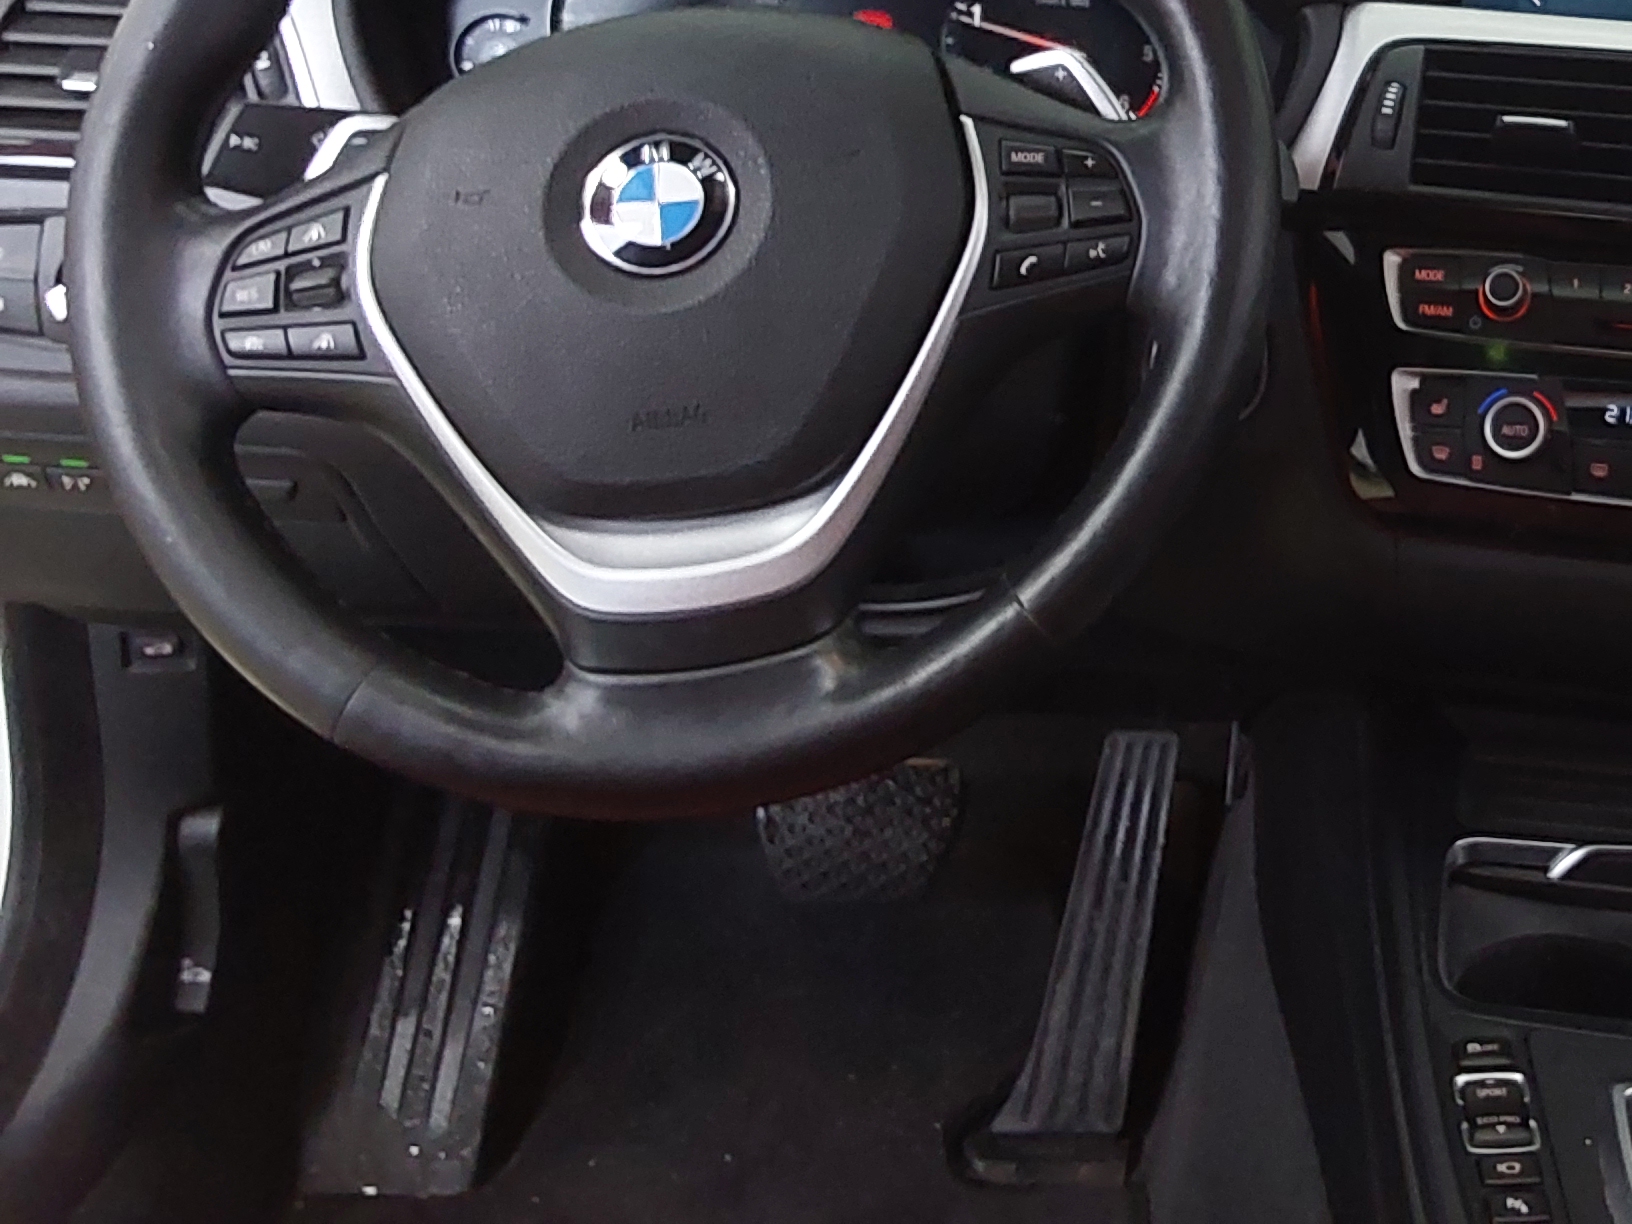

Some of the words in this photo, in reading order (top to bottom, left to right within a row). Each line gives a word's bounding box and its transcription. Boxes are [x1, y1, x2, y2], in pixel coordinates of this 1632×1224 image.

[969, 3, 982, 27] 1
[1011, 151, 1045, 164] MODE
[1414, 269, 1445, 282] MODE
[1573, 278, 1579, 290] 1
[1623, 283, 1632, 294] 2
[1501, 425, 1528, 437] AUTO
